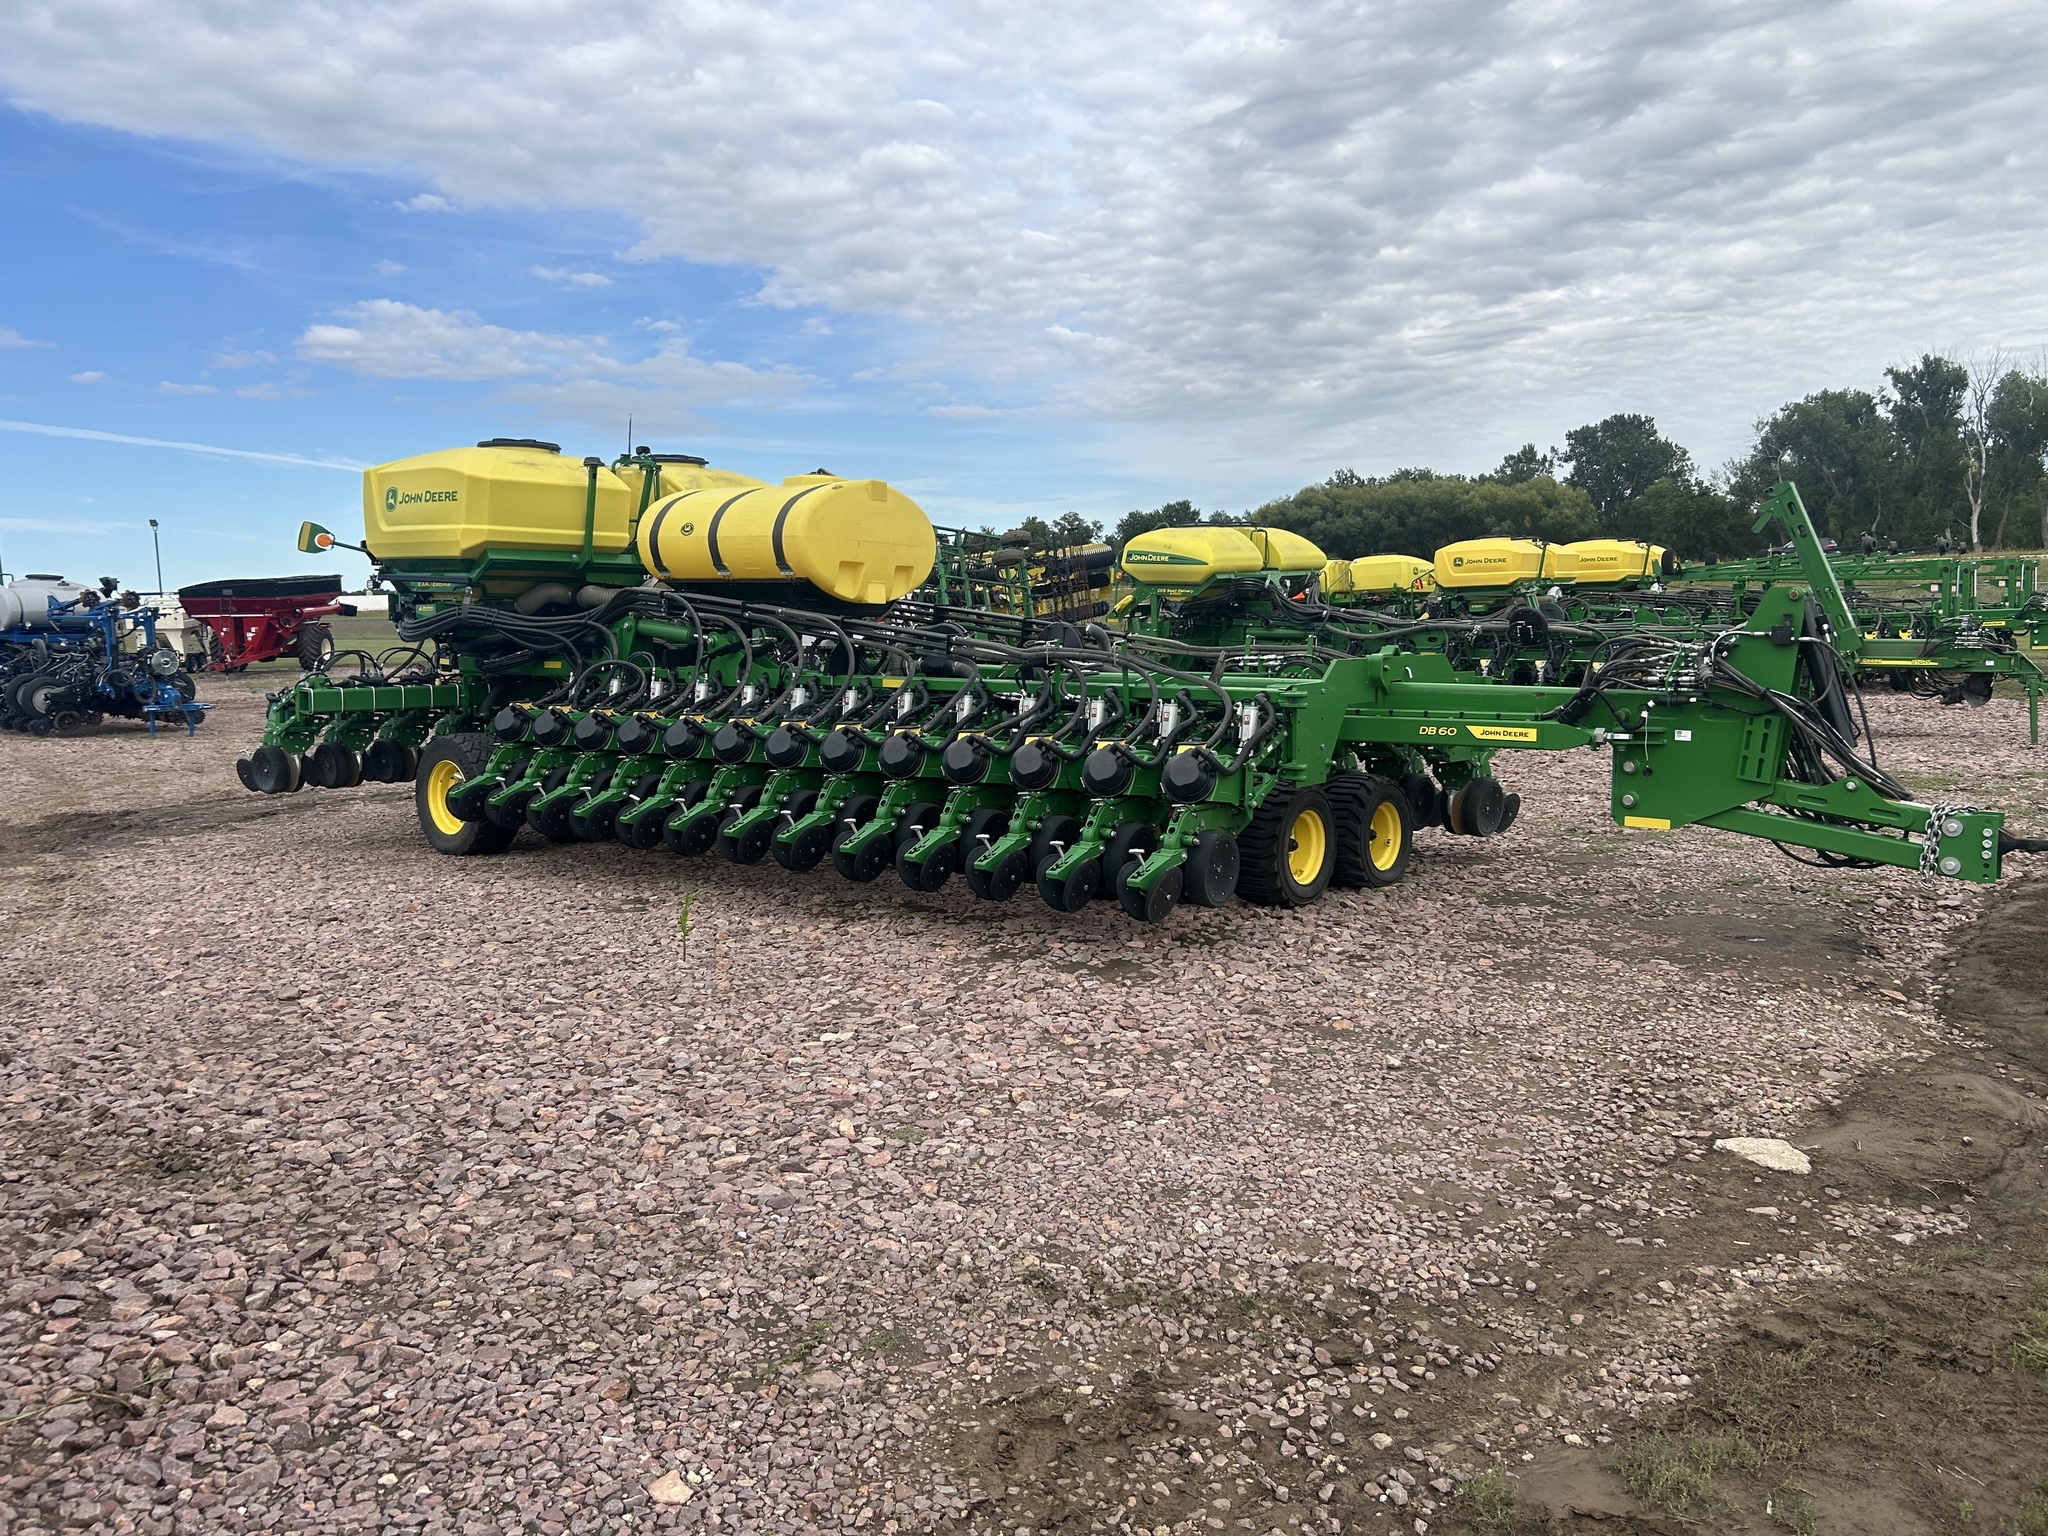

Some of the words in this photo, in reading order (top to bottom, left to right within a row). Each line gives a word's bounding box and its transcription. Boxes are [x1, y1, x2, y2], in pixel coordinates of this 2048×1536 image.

[399, 492, 423, 504] JOHN
[424, 490, 458, 502] DEERE
[1480, 729, 1501, 737] JOHN
[1503, 730, 1529, 738] DEERE
